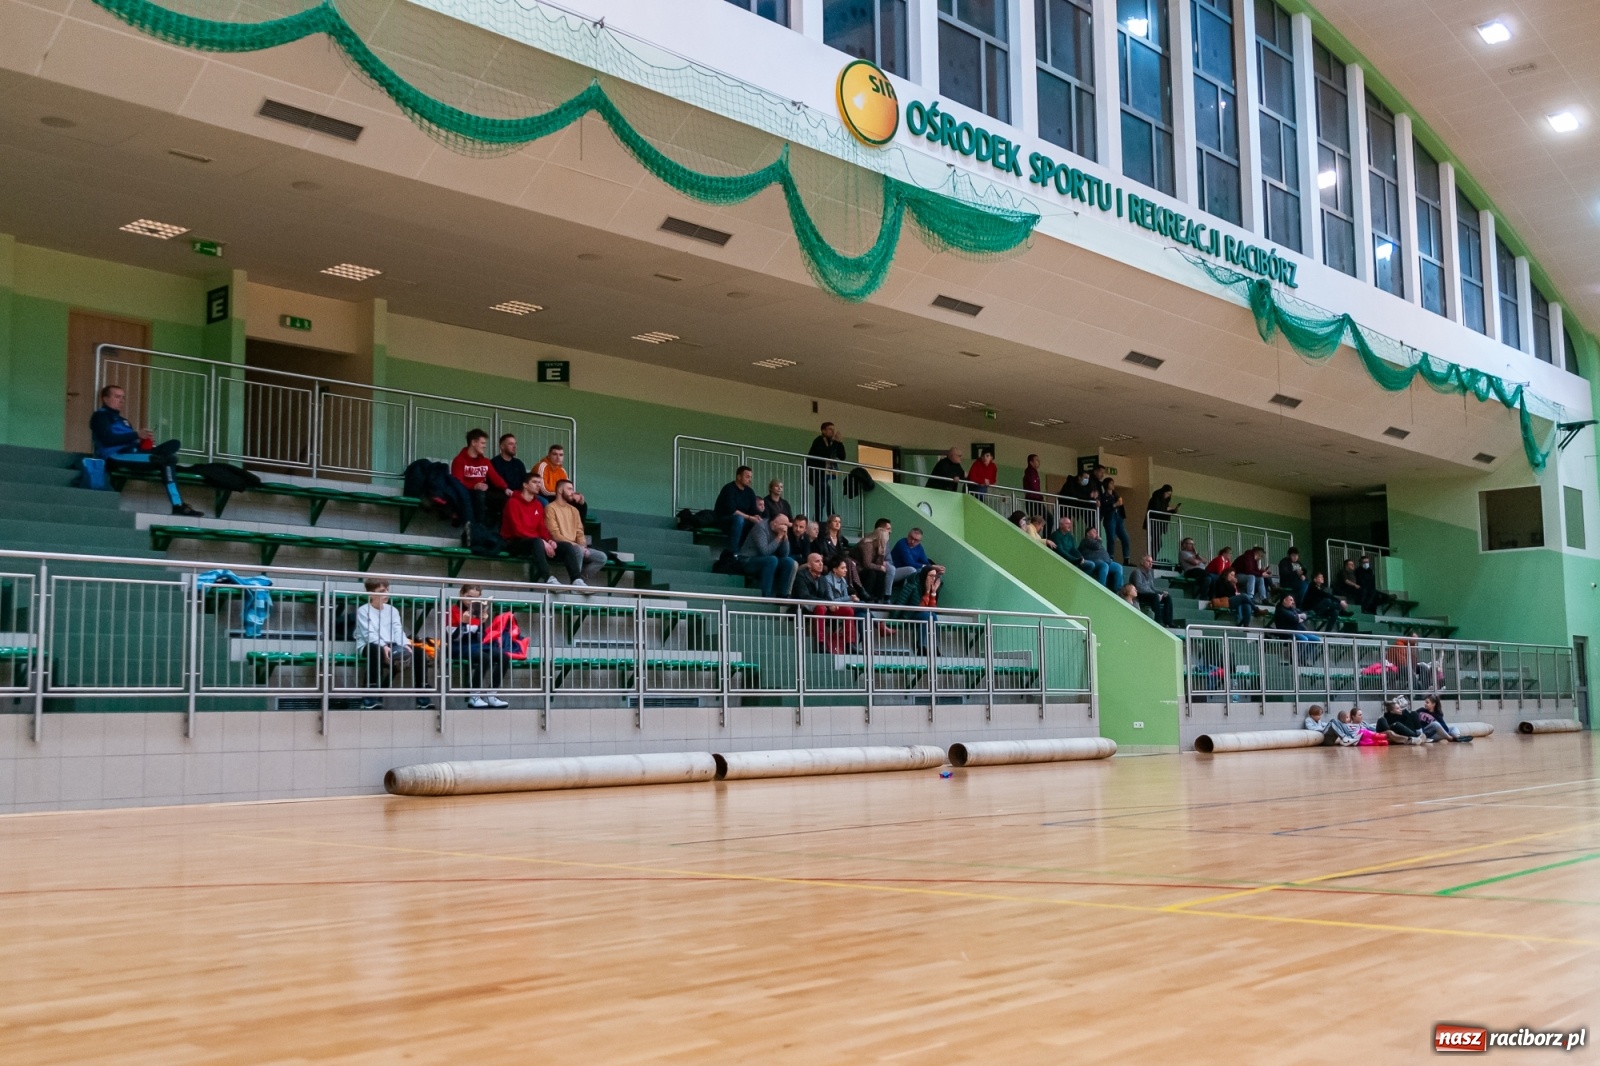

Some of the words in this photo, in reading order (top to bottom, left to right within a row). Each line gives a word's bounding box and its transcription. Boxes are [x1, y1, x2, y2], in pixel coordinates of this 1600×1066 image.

[906, 100, 1022, 177] OŚRODEK
[1029, 152, 1112, 211] SPORTU
[1116, 188, 1123, 217] I
[1128, 193, 1221, 258] REKREACJI
[1224, 234, 1298, 288] RACIBÓRZ
[212, 299, 224, 318] E
[546, 368, 561, 380] E
